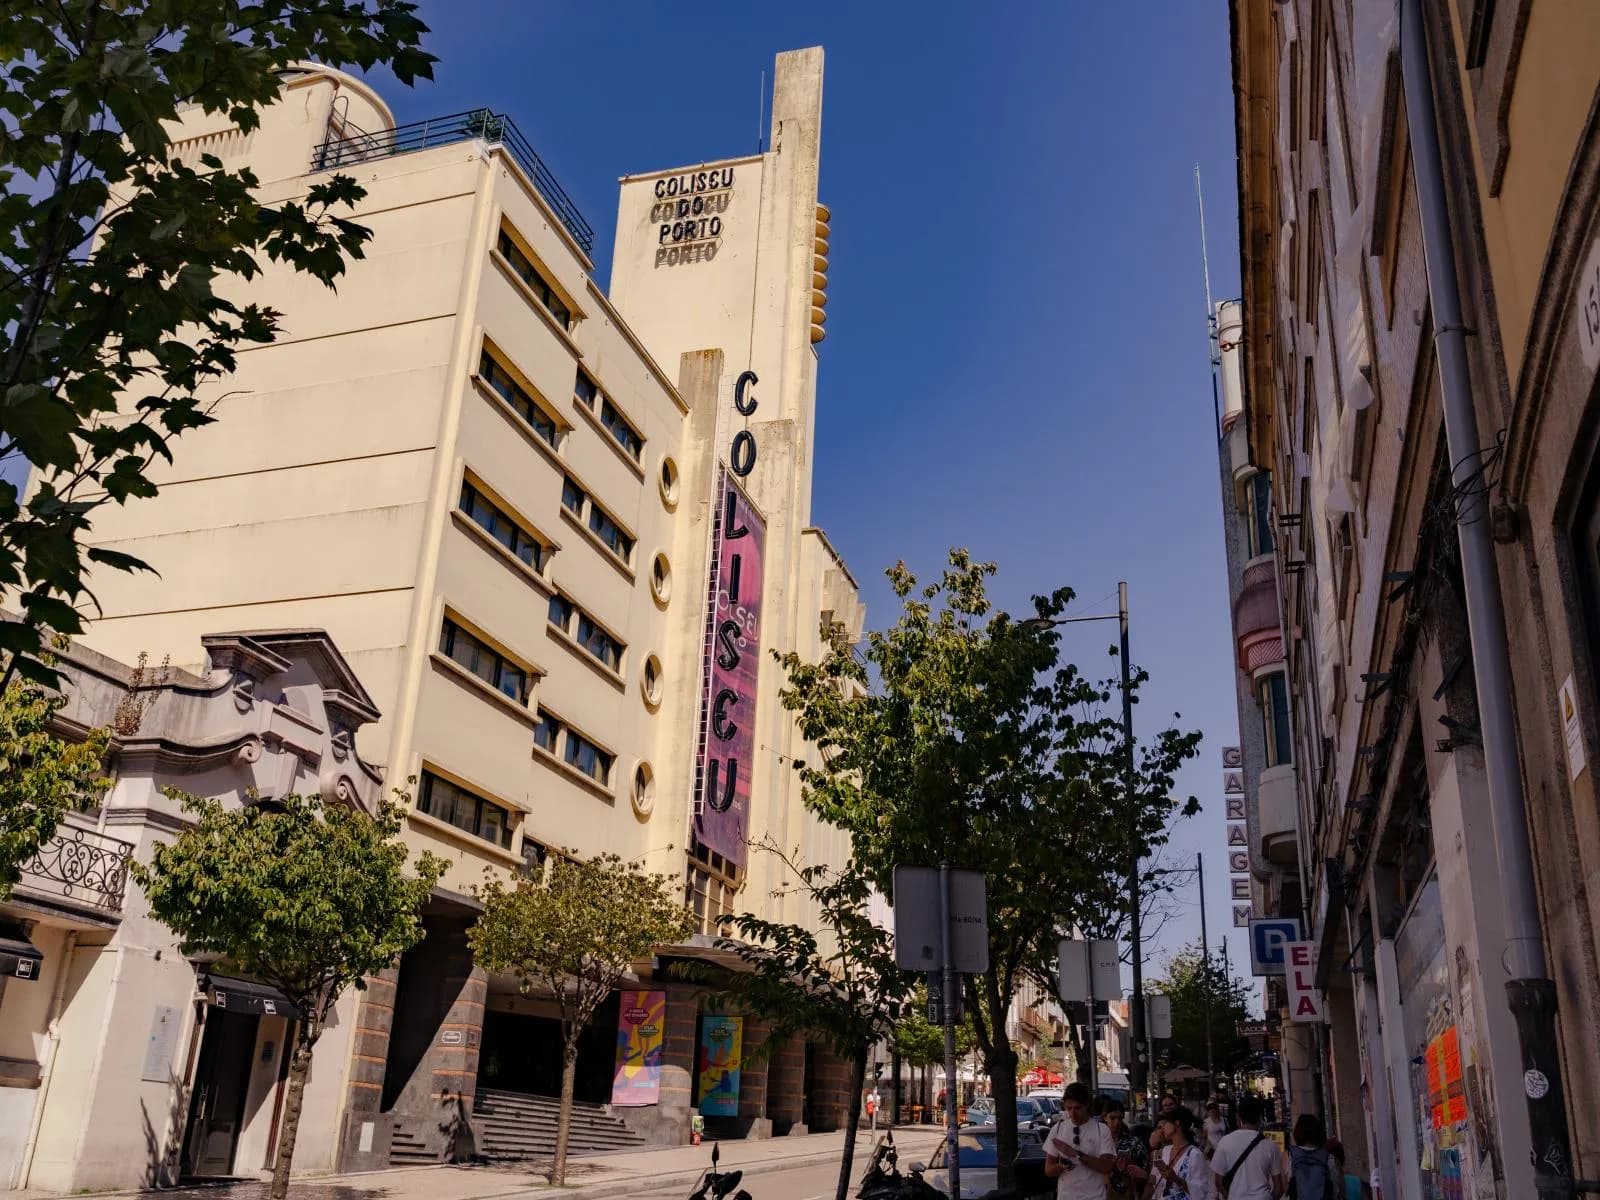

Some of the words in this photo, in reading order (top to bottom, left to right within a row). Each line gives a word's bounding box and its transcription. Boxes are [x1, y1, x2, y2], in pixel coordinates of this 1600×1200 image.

[655, 168, 734, 198] COLISEU
[677, 195, 704, 218] DO
[659, 217, 721, 243] PORTO
[708, 371, 759, 812] COLISEU
[1223, 748, 1251, 926] GARAGEM
[1264, 929, 1287, 960] P
[1292, 946, 1317, 1016] ELA
